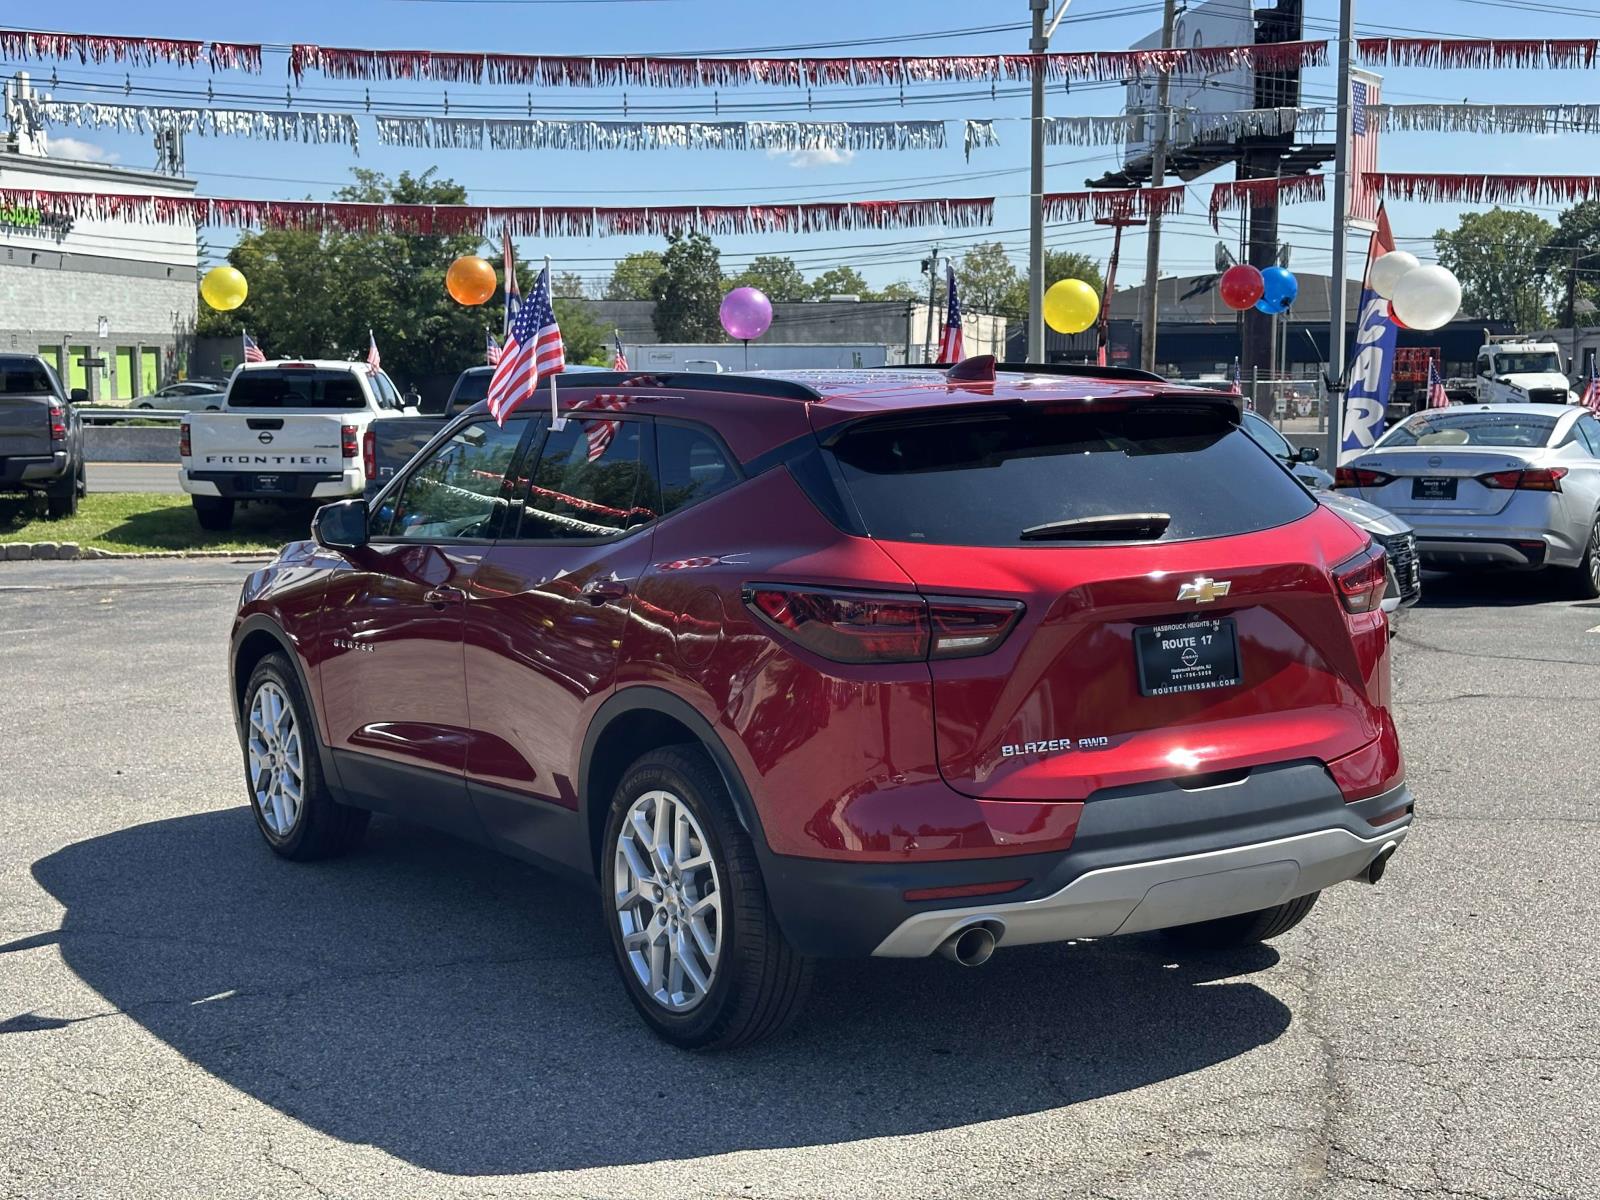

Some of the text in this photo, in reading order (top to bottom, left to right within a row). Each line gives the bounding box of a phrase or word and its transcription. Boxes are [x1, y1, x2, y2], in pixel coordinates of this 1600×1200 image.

[206, 456, 328, 464] FRONTIER
[1153, 622, 1187, 632] HASBROUCK
[333, 638, 374, 652] BLAZER
[1162, 635, 1213, 650] ROUTE 17
[1153, 679, 1235, 695] ROUTE17NISSAN.COM
[1002, 736, 1108, 757] BLAZER AWD
